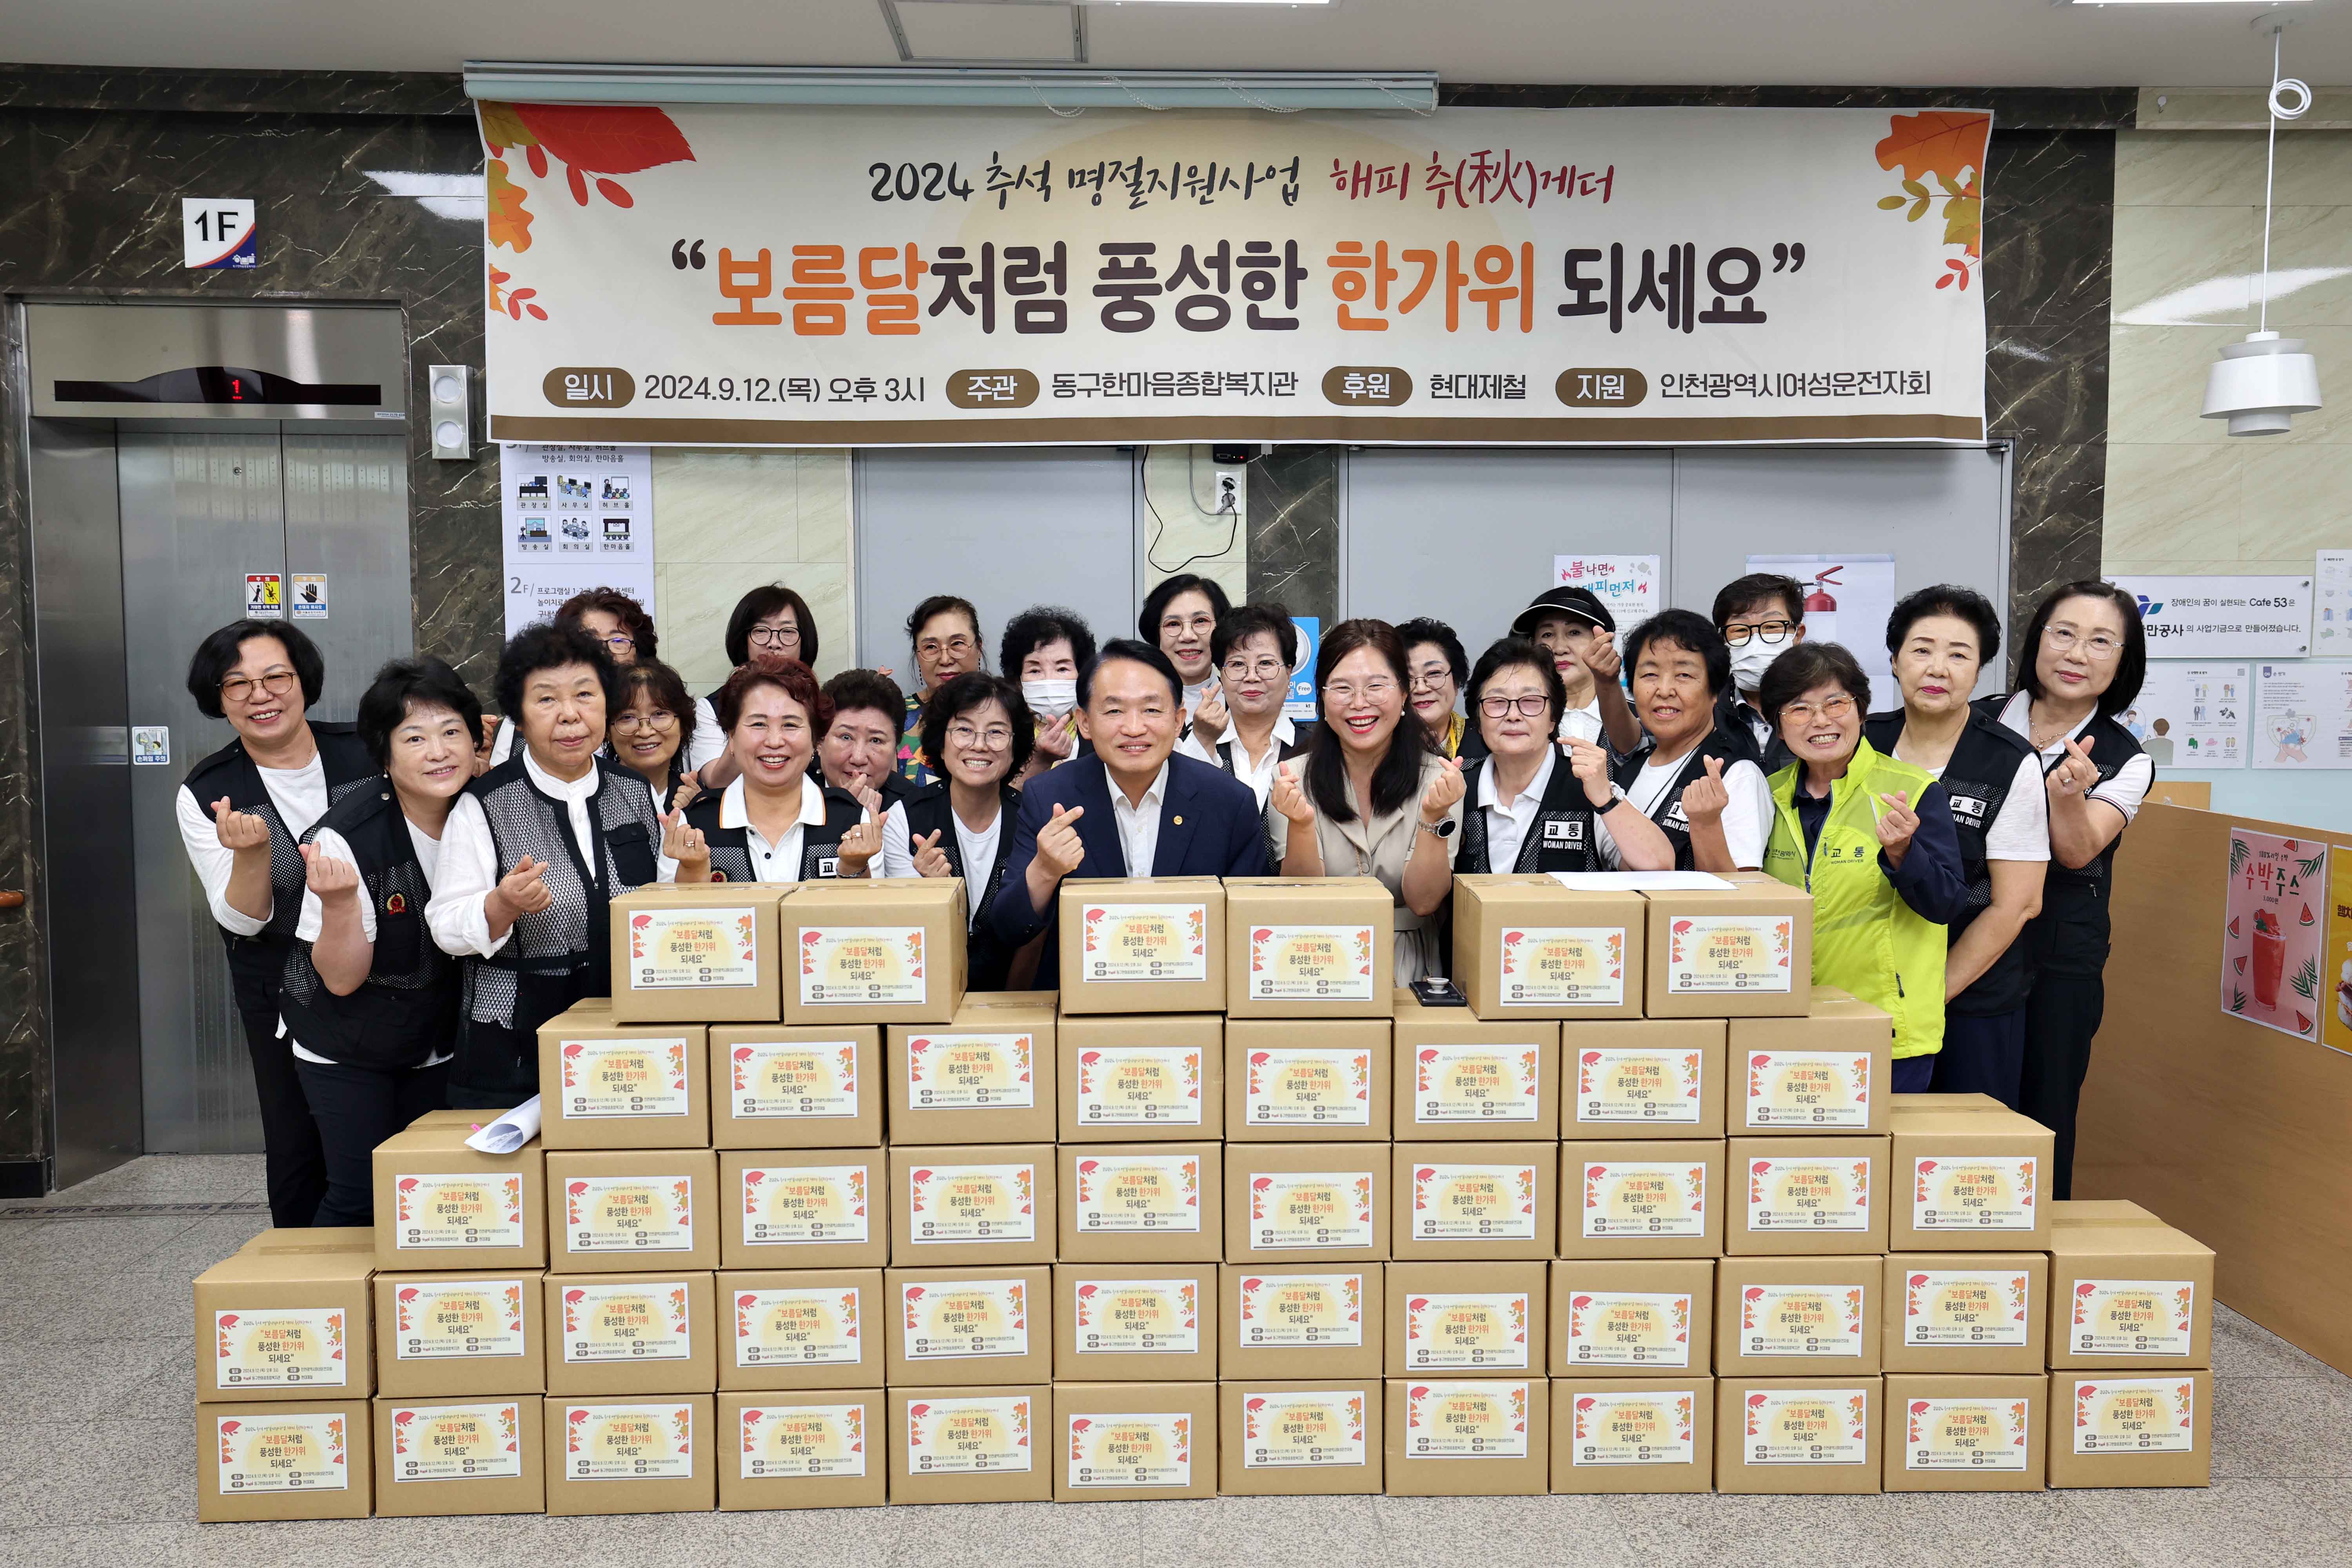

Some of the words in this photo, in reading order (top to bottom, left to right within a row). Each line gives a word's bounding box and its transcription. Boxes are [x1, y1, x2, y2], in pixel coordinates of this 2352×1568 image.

[869, 162, 974, 201] 2024
[986, 151, 1051, 210] 추석
[1068, 156, 1299, 209] 명절지원사업
[1330, 158, 1410, 200] 해피
[1426, 149, 1614, 209] 추(秋)게더
[194, 209, 238, 241] 1F
[672, 239, 1067, 336] “보름달처럼
[1093, 240, 1308, 333] 풍성한
[1327, 240, 1534, 333] 한가위
[1558, 242, 1805, 334] 되세요”
[232, 379, 242, 399] 1
[564, 374, 613, 401] 일시
[645, 375, 820, 402] 2024.9.12.(목)
[828, 377, 877, 402] 오후
[885, 377, 924, 401] 3시
[967, 376, 1017, 402] 주관
[1052, 372, 1298, 398] 동구한마음종합복지관
[1342, 372, 1392, 400] 후원
[1430, 374, 1525, 399] 현대제철
[1577, 373, 1624, 401] 지원
[1661, 371, 1930, 397] 인천광역시여성운전자회
[595, 454, 624, 463] 한마음홀
[1570, 560, 1608, 578] 불나면
[2171, 598, 2201, 607] 장애인의
[2202, 598, 2217, 607] 꿈이
[2220, 598, 2247, 607] 실현되는
[2249, 597, 2271, 607] Cafe
[2143, 624, 2184, 637] 만공사
[2196, 624, 2242, 633] 사업기금으로
[2245, 624, 2301, 633] 만들어졌습니다.
[1965, 817, 1981, 828] DRIVER
[1543, 840, 1564, 849] WOMAN
[1564, 841, 1582, 850] DRIVER
[2246, 862, 2300, 897] 수박주스
[1123, 936, 1144, 946] 풍성한
[1146, 936, 1167, 946] 한가위
[670, 942, 692, 952] 풍성한
[694, 942, 716, 951] 한가위
[1709, 948, 1730, 958] 풍성한
[1732, 948, 1753, 957] 한가위
[1118, 1080, 1139, 1089] 풍성한
[1141, 1080, 1162, 1089] 한가위
[1787, 1083, 1808, 1093] 풍성한
[1809, 1083, 1831, 1093] 한가위
[1116, 1188, 1137, 1197] 풍성한
[1139, 1188, 1160, 1197] 한가위
[1953, 1187, 1974, 1196] 풍성한
[1976, 1187, 1997, 1196] 한가위
[437, 1205, 459, 1214] 풍성한
[461, 1205, 483, 1214] 한가위
[1945, 1302, 1966, 1311] 풍성한
[1968, 1302, 1989, 1311] 한가위
[2110, 1311, 2131, 1321] 풍성한
[2133, 1312, 2154, 1321] 한가위
[258, 1342, 280, 1352] 풍성한
[282, 1342, 305, 1351] 한가위
[260, 1447, 282, 1457] 풍성한
[284, 1446, 306, 1456] 한가위
